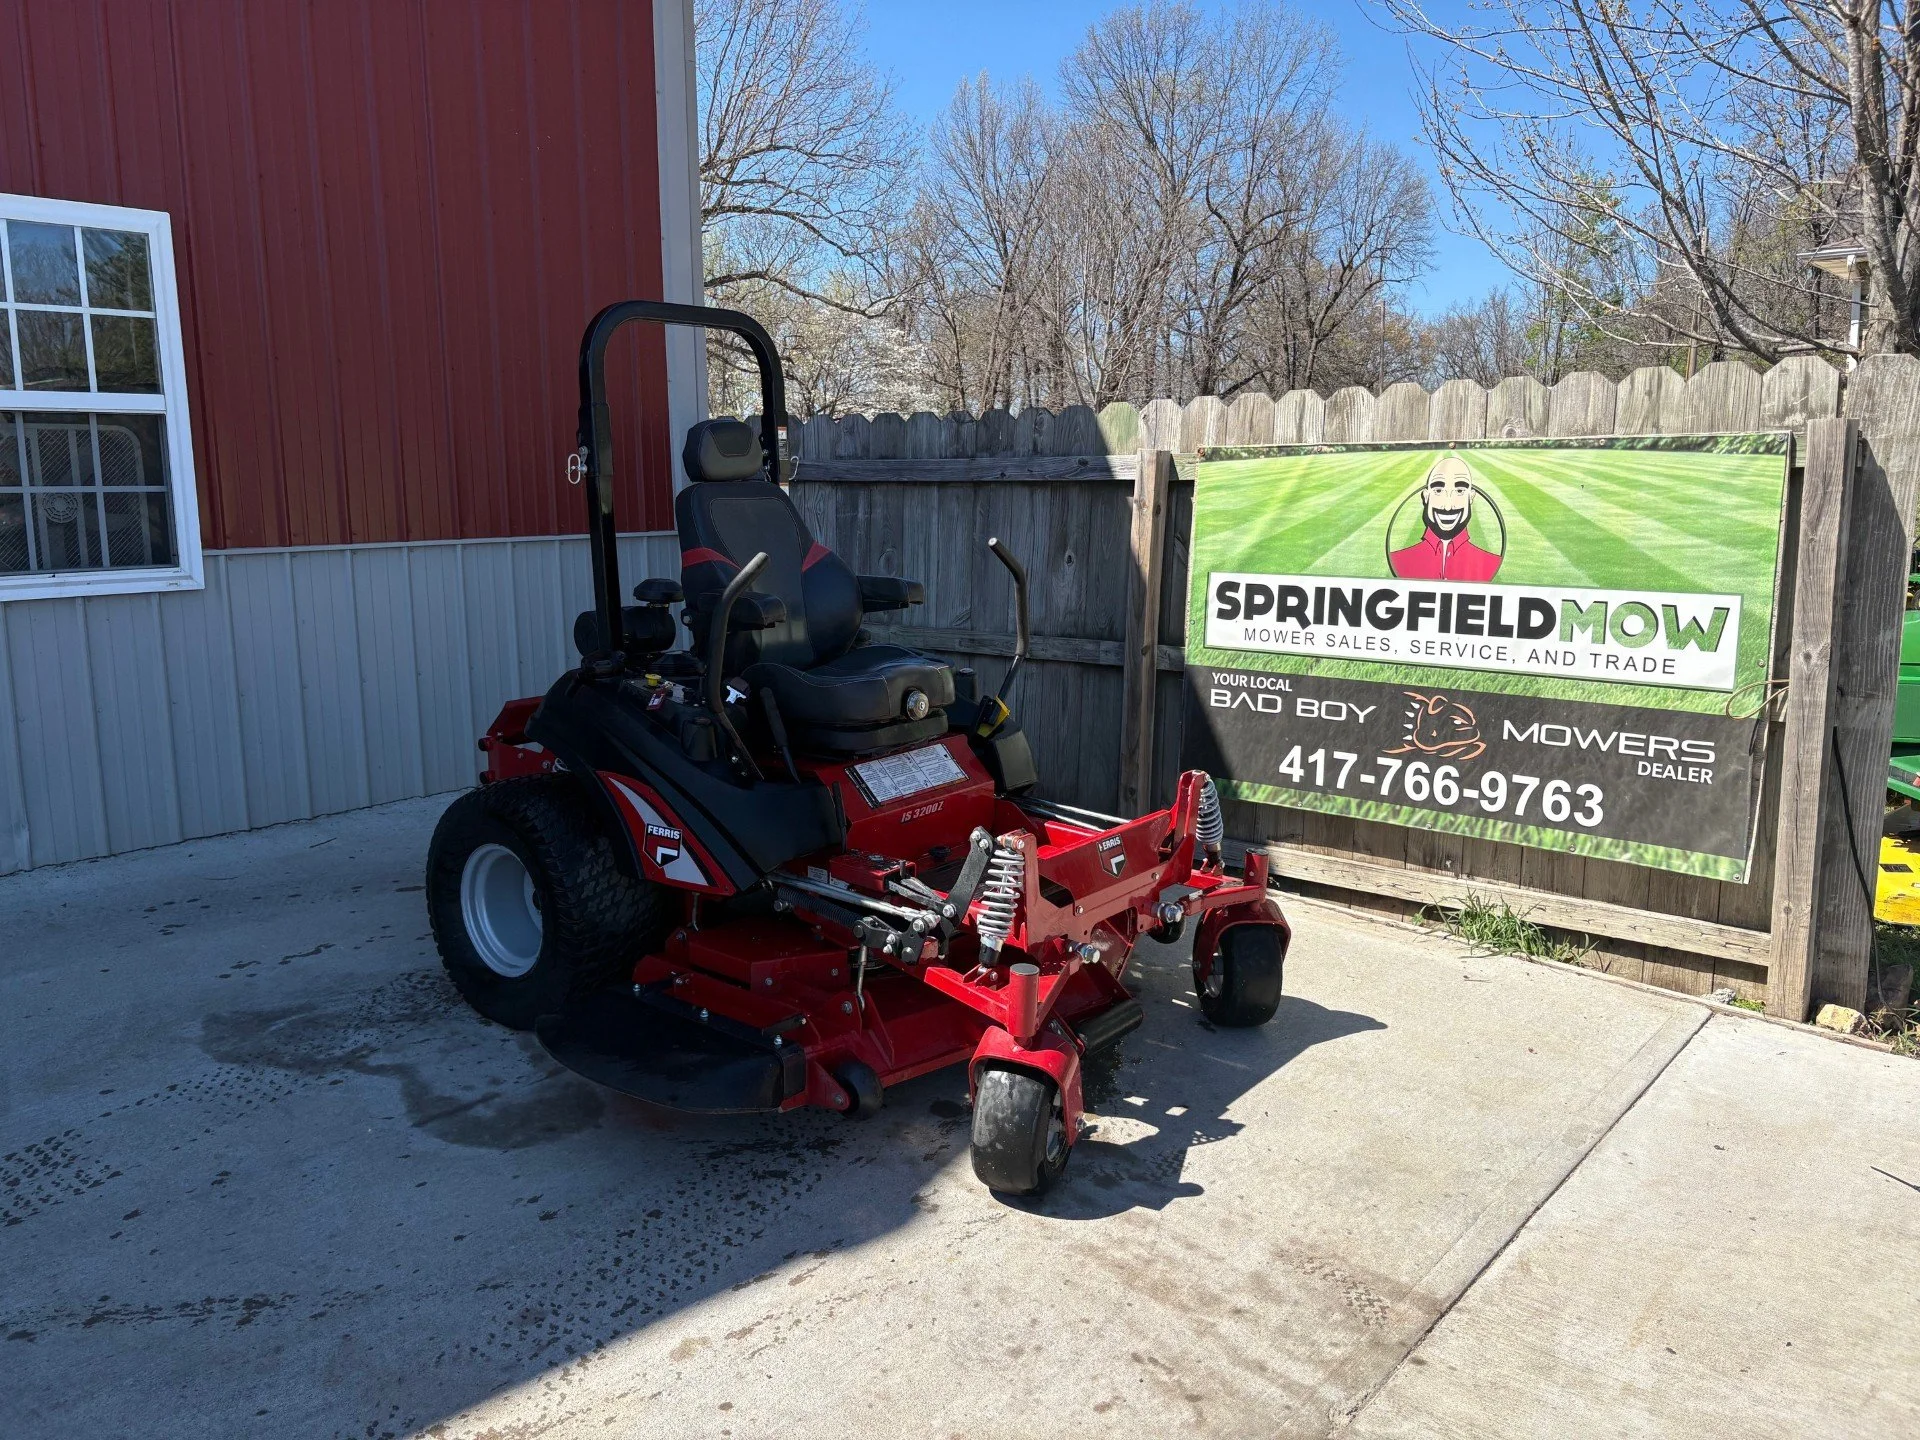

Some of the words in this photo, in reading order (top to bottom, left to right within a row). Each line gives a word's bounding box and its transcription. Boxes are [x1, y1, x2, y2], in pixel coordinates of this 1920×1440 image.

[1244, 628, 1316, 646] MOWER
[1326, 633, 1399, 654] SALES,
[1409, 640, 1516, 663] SERVICE,
[1527, 648, 1577, 667] AND
[1590, 652, 1676, 674] TRADE
[1212, 672, 1248, 688] YOUR
[1249, 674, 1292, 692] LOCAL
[1209, 689, 1282, 714] BAD
[1295, 698, 1376, 723] BOY
[1503, 720, 1715, 763] MOWERS
[1637, 761, 1713, 784] DEALER
[1278, 746, 1604, 827] 417-766-9763
[901, 811, 912, 822] IS
[913, 801, 944, 817] 3200Z
[648, 825, 680, 839] FERRIS
